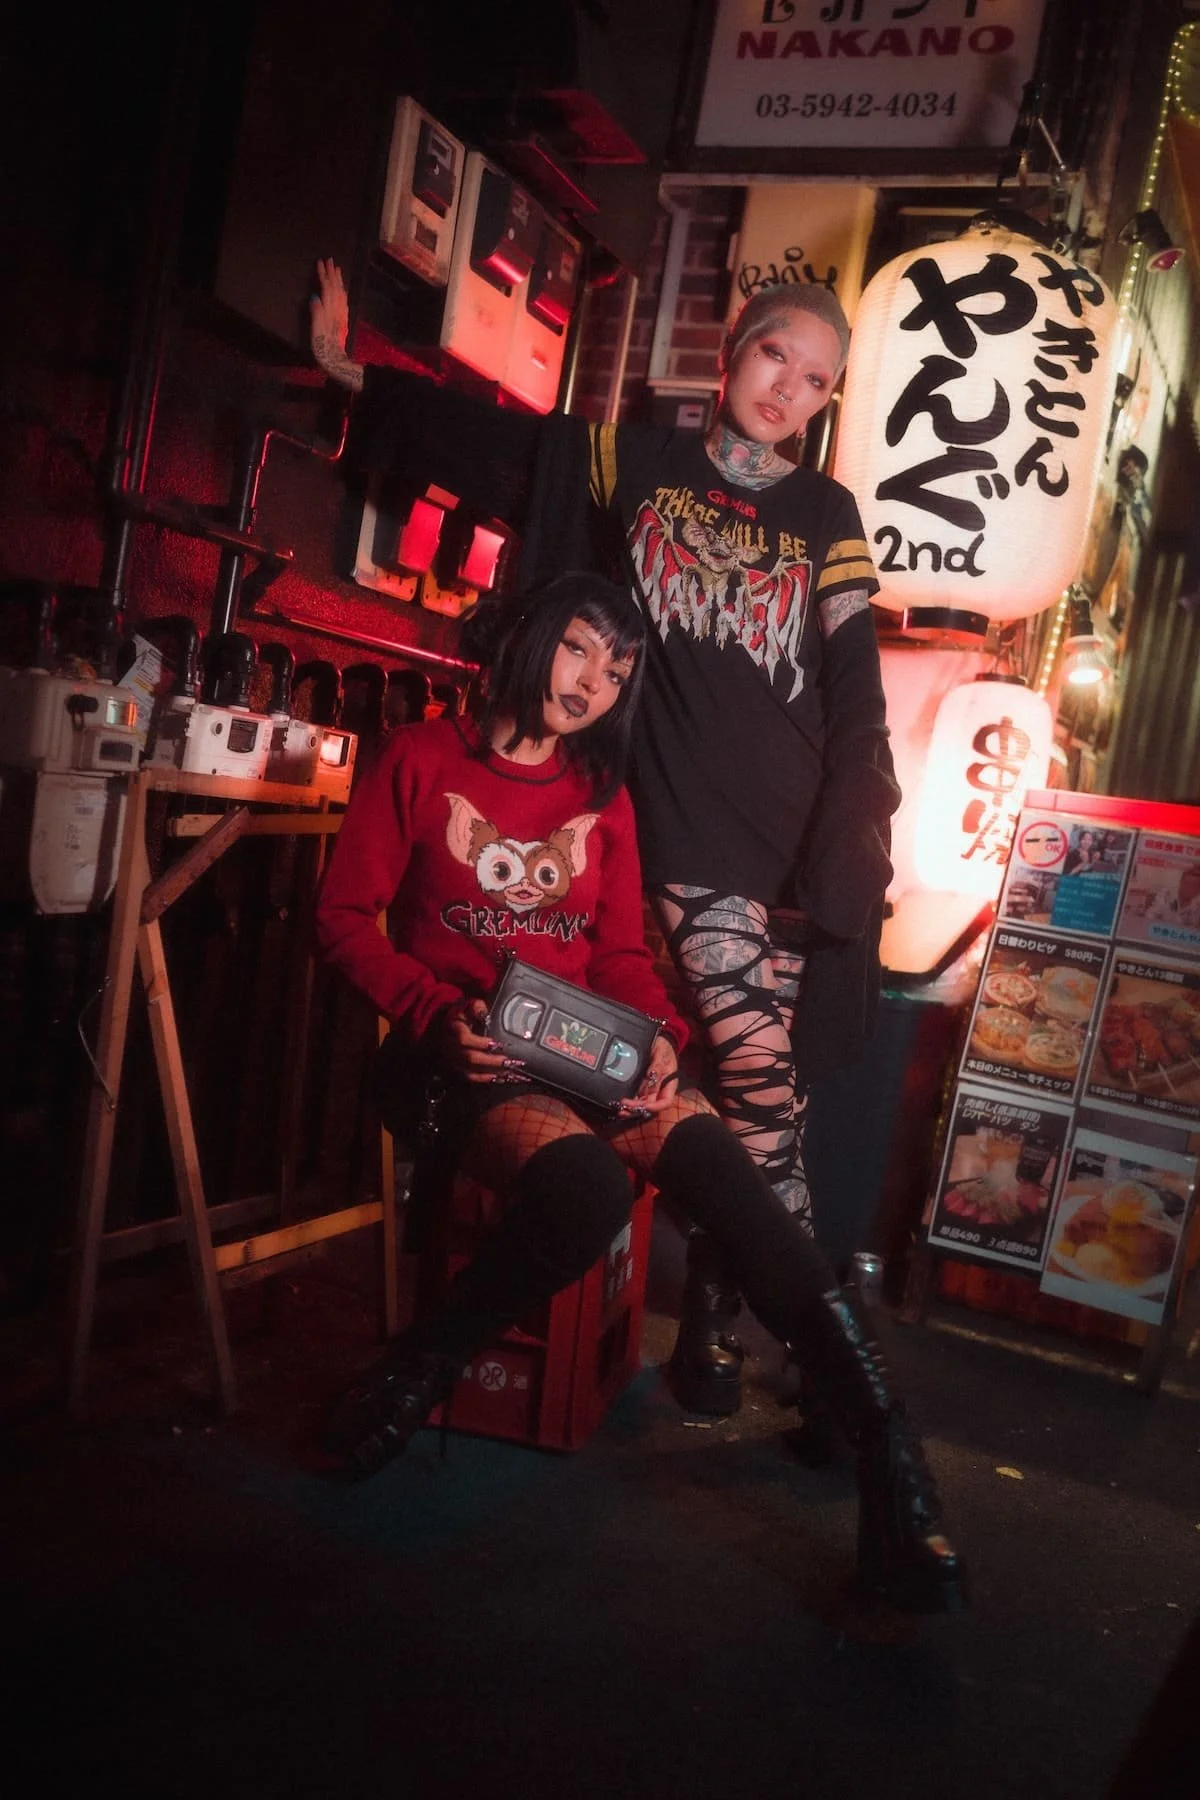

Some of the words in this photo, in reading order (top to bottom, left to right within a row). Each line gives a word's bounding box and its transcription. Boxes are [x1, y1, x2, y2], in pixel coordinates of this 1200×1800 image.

[736, 25, 1015, 60] NAKANO
[755, 92, 959, 118] 03-5942-4034
[875, 253, 1038, 532] やんぐ
[1014, 251, 1106, 498] やきとん
[778, 531, 809, 562] BE
[874, 525, 987, 577] 2nd
